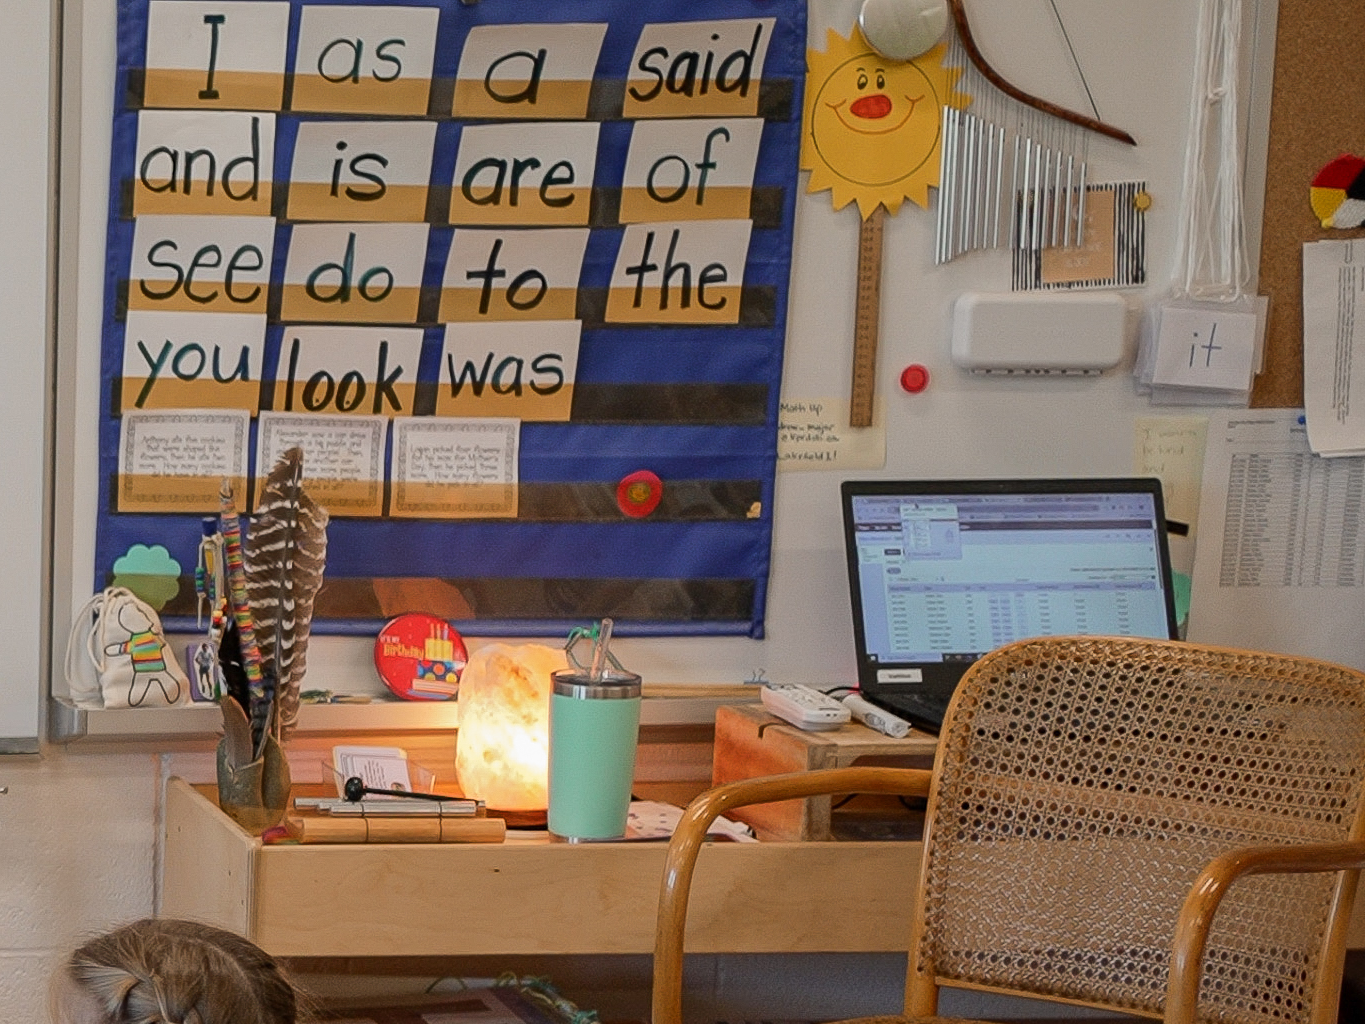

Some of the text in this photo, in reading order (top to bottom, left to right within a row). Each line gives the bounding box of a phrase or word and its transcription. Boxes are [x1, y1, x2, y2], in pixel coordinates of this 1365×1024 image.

[198, 14, 764, 105] I as a said
[139, 116, 730, 208] and is are of
[140, 228, 729, 314] see do to the
[136, 337, 565, 414] you look was
[1189, 322, 1222, 369] it
